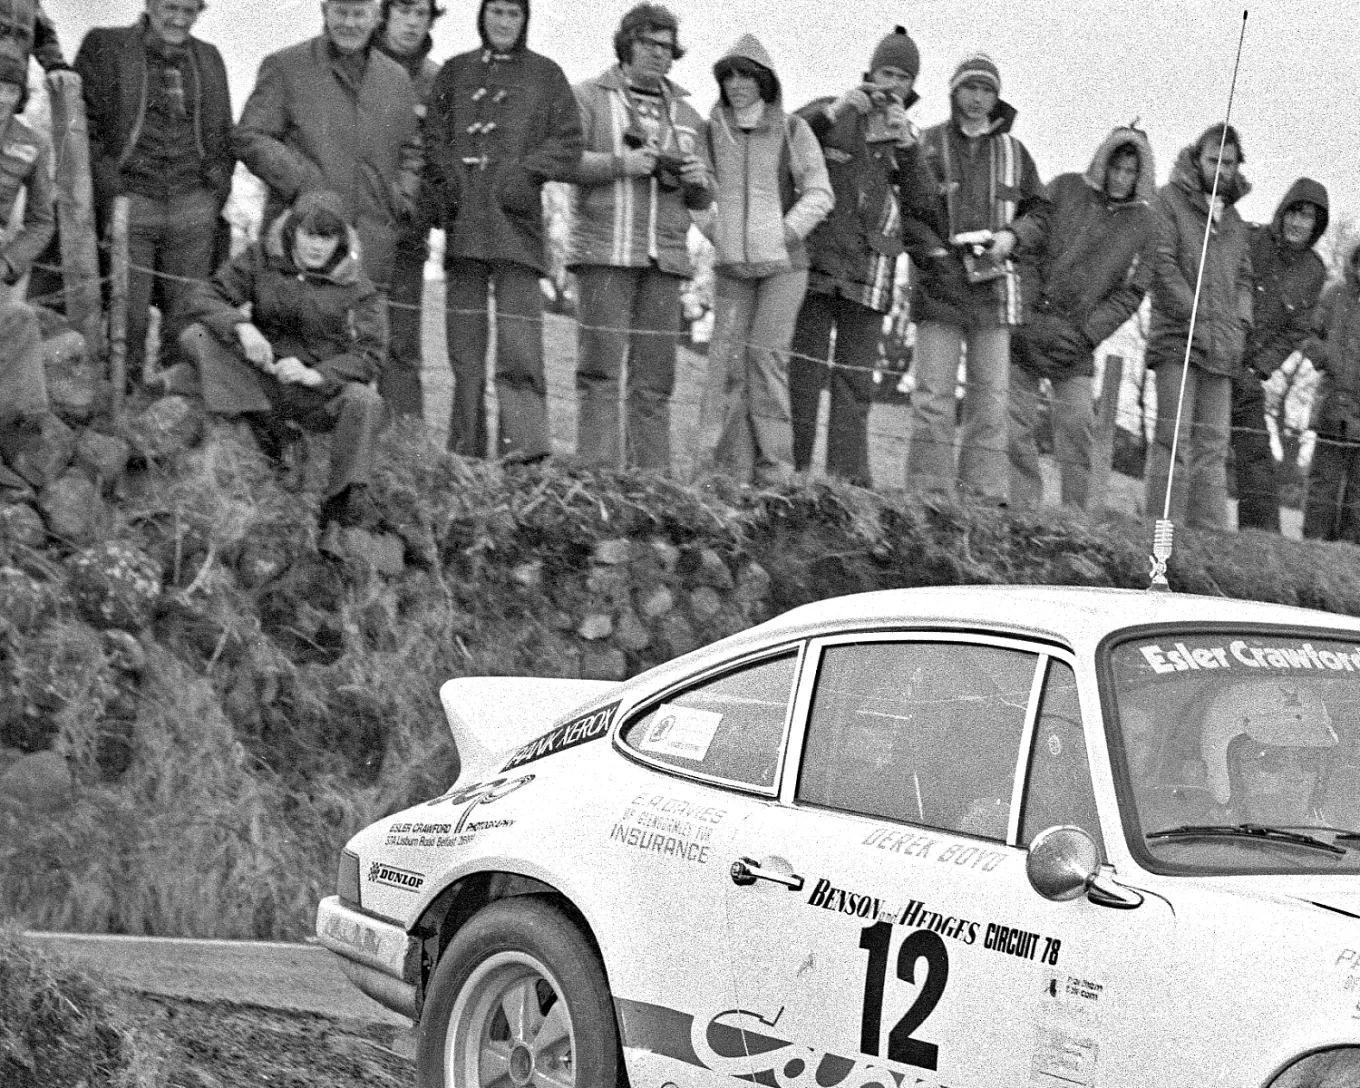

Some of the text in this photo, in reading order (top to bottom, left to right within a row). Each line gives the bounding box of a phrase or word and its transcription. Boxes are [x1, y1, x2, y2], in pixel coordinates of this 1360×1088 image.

[1139, 641, 1231, 674] Esler
[555, 707, 617, 748] XEROX
[610, 823, 710, 864] INSURANCE
[862, 828, 1008, 872] DEREK BOYD
[379, 869, 424, 888] DUNLOP
[807, 878, 886, 920] BENSON
[899, 899, 981, 945] HEDGES
[984, 923, 1040, 961] CIRCUIT
[1041, 937, 1062, 965] 78
[858, 920, 949, 1071] 12
